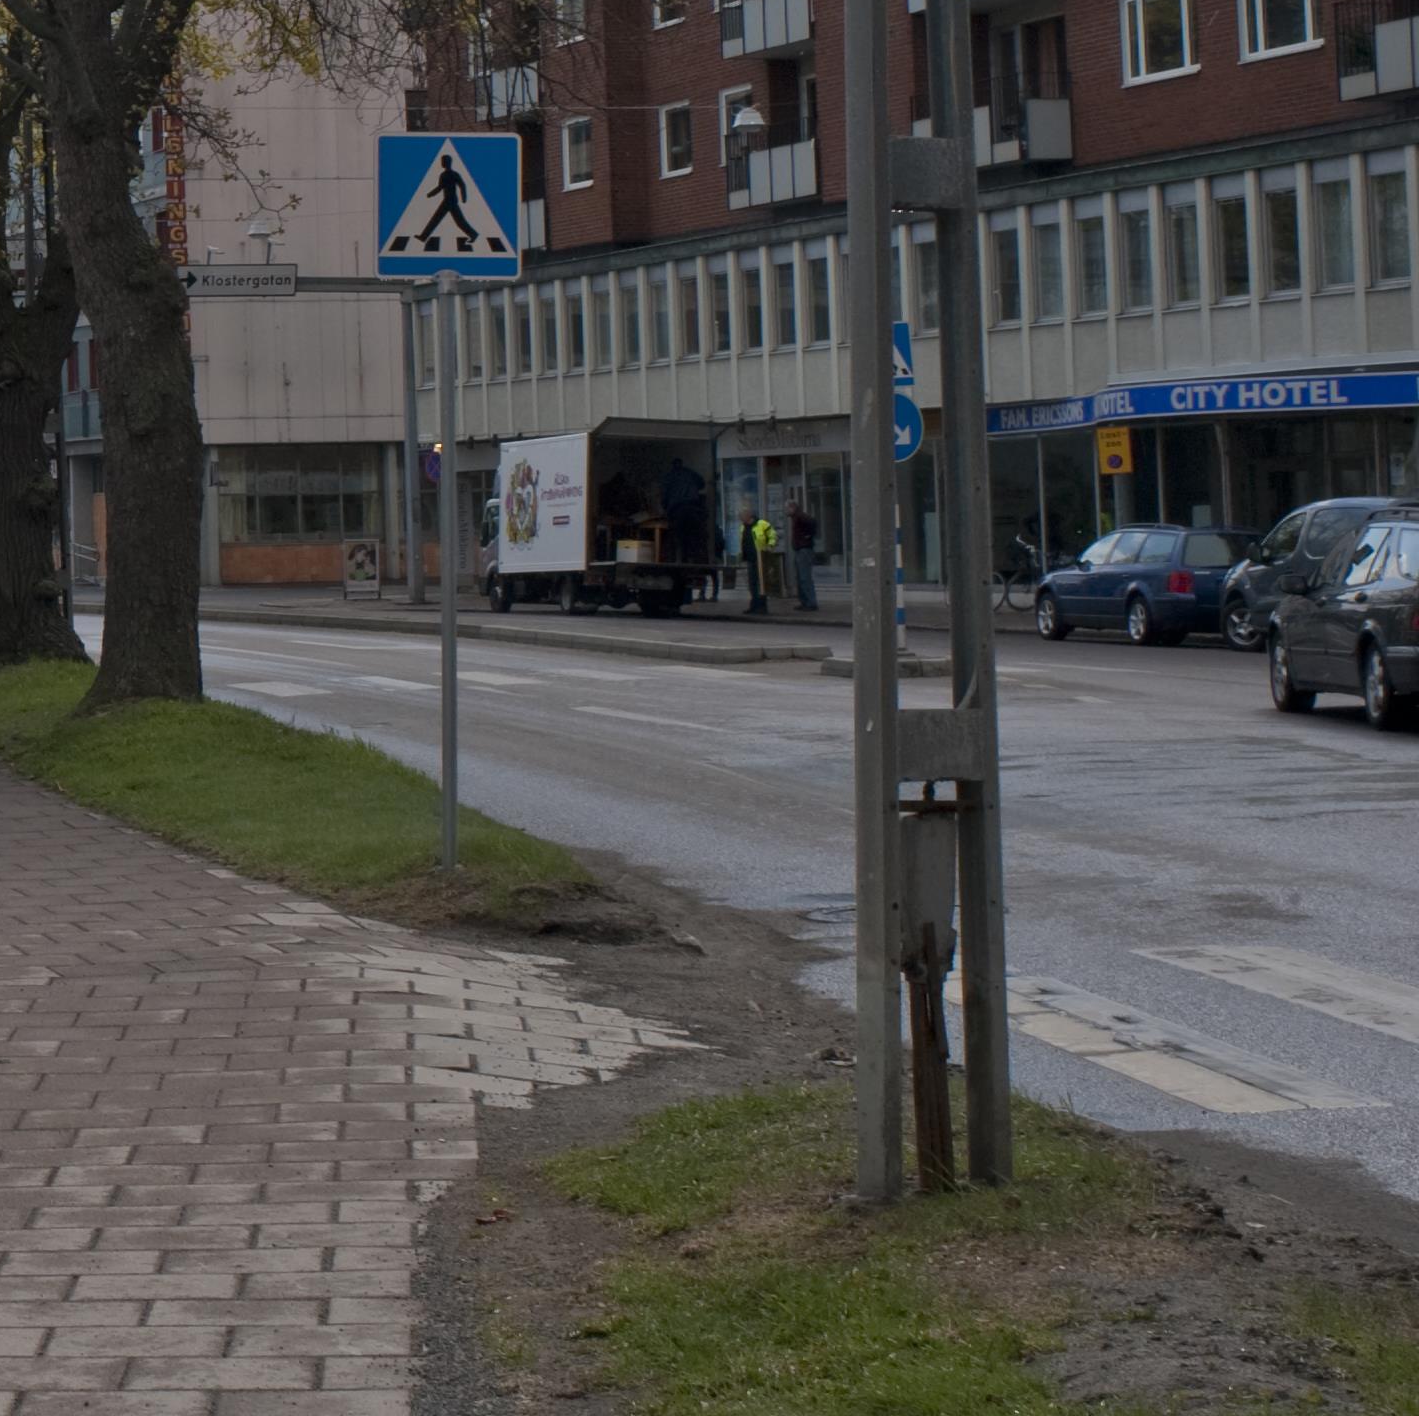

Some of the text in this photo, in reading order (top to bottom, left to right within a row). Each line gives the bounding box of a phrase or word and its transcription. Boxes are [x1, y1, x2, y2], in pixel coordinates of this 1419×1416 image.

[202, 274, 292, 289] Klostergatan
[1169, 380, 1349, 410] CITY HOTEL
[1000, 408, 1029, 429] FAM.
